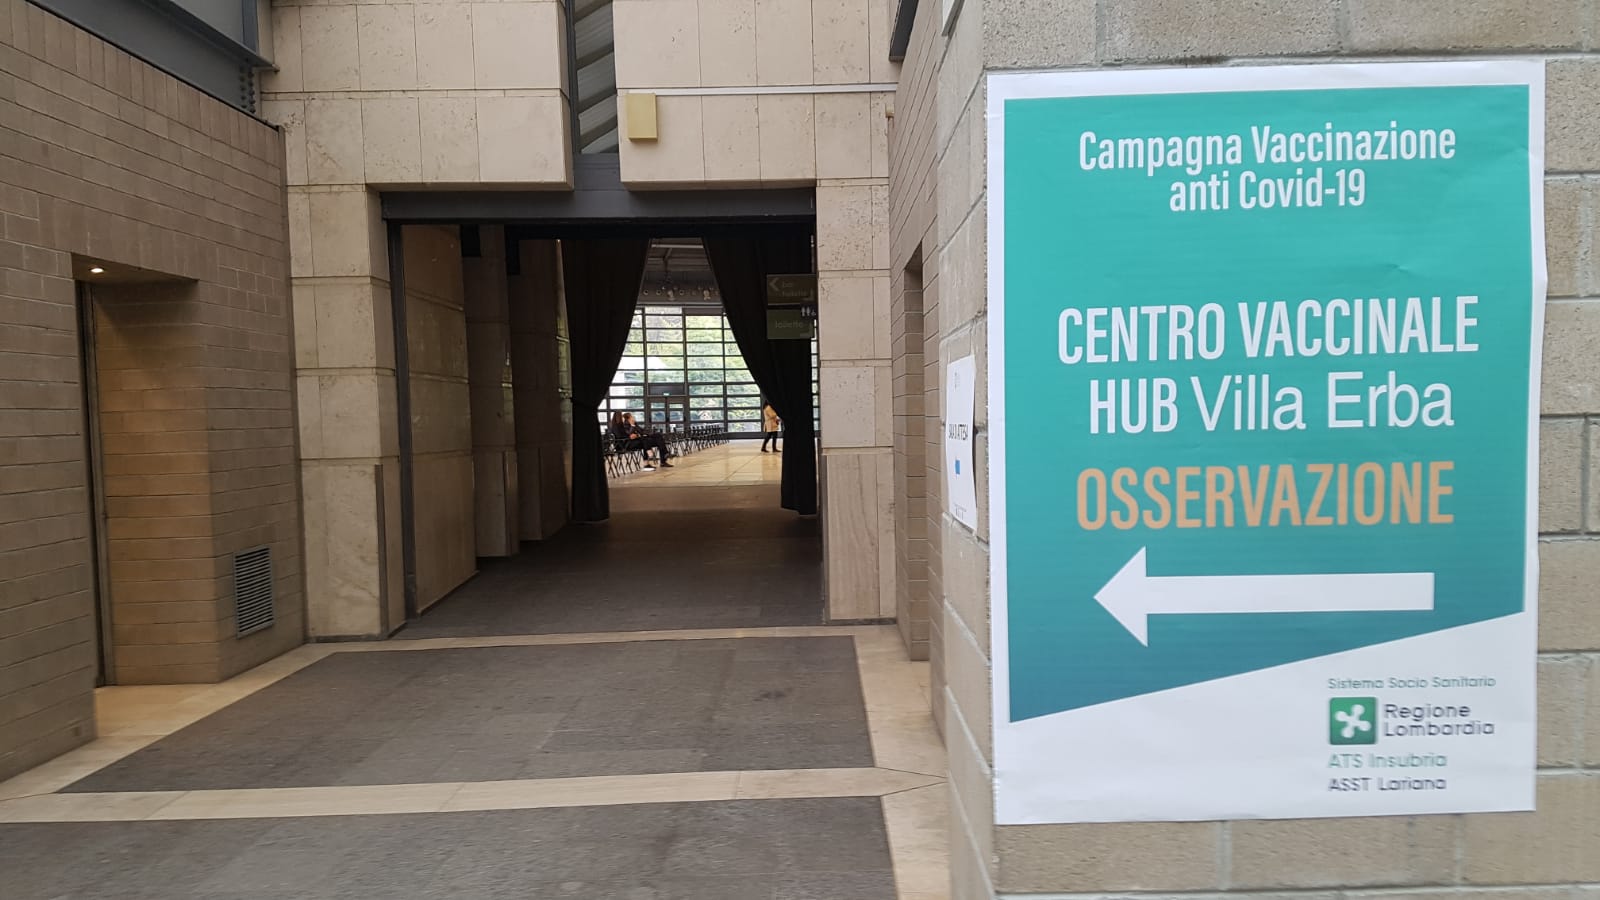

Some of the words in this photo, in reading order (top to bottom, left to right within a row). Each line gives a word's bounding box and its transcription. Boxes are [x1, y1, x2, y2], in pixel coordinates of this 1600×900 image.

[1080, 131, 1242, 176] Campagna
[1252, 121, 1455, 163] Vaccinazione
[1170, 171, 1229, 211] anti
[1240, 168, 1365, 209] Covid-19
[1059, 303, 1224, 364] CENTRO
[1239, 296, 1478, 357] VACCINALE
[1091, 378, 1177, 433] HUB
[1191, 374, 1306, 431] Villa
[1328, 371, 1454, 428] Erba
[1078, 462, 1453, 529] OSSERVAZIONE
[1328, 678, 1384, 689] Sistema
[1388, 677, 1428, 688] Socio
[1432, 676, 1496, 687] Sanitario
[1384, 704, 1471, 721] Regione
[1384, 720, 1495, 736] Lombardia
[1328, 754, 1363, 768] ATS
[1370, 753, 1447, 767] Insubria
[1328, 777, 1372, 791] ASST
[1378, 777, 1446, 791] Lariana
